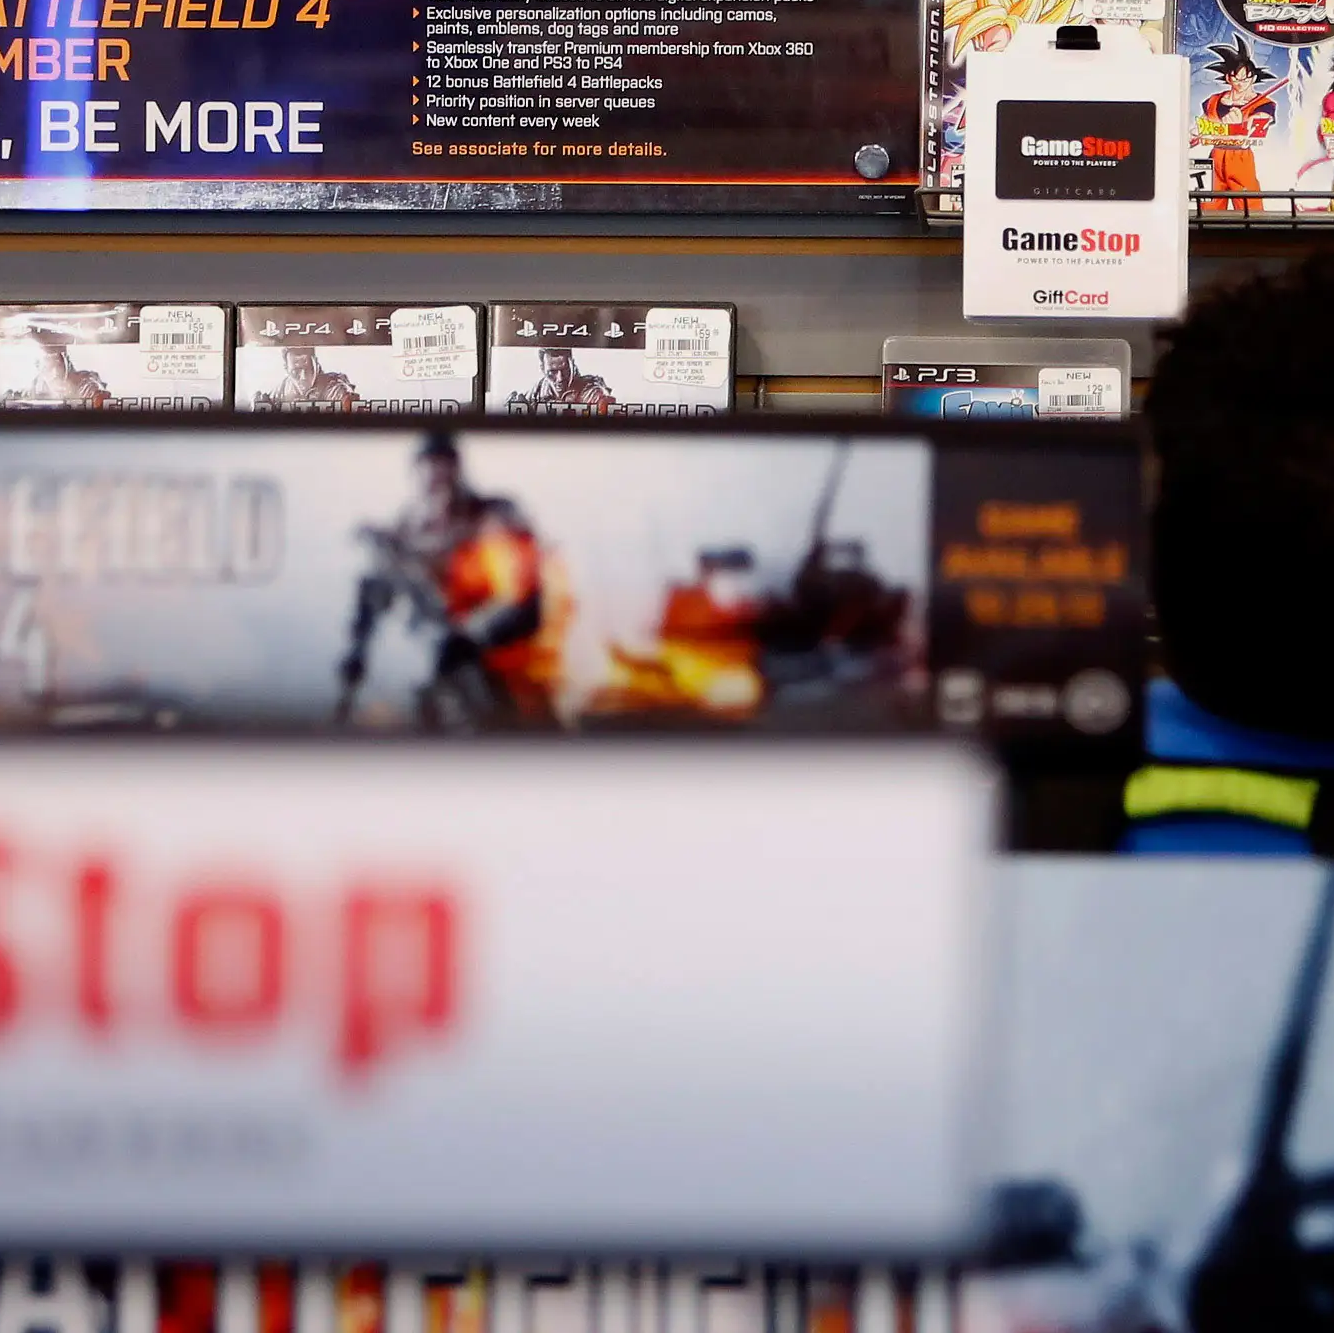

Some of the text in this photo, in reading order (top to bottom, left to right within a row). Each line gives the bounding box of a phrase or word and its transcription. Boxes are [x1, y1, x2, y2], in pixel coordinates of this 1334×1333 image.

[38, 100, 117, 152] BE
[145, 100, 324, 153] MORE
[1020, 135, 1132, 162] GameStop
[1033, 159, 1118, 167] POWER TO THE PLAYERS
[1002, 227, 1140, 255] GameStop
[1032, 289, 1109, 305] GiftCard
